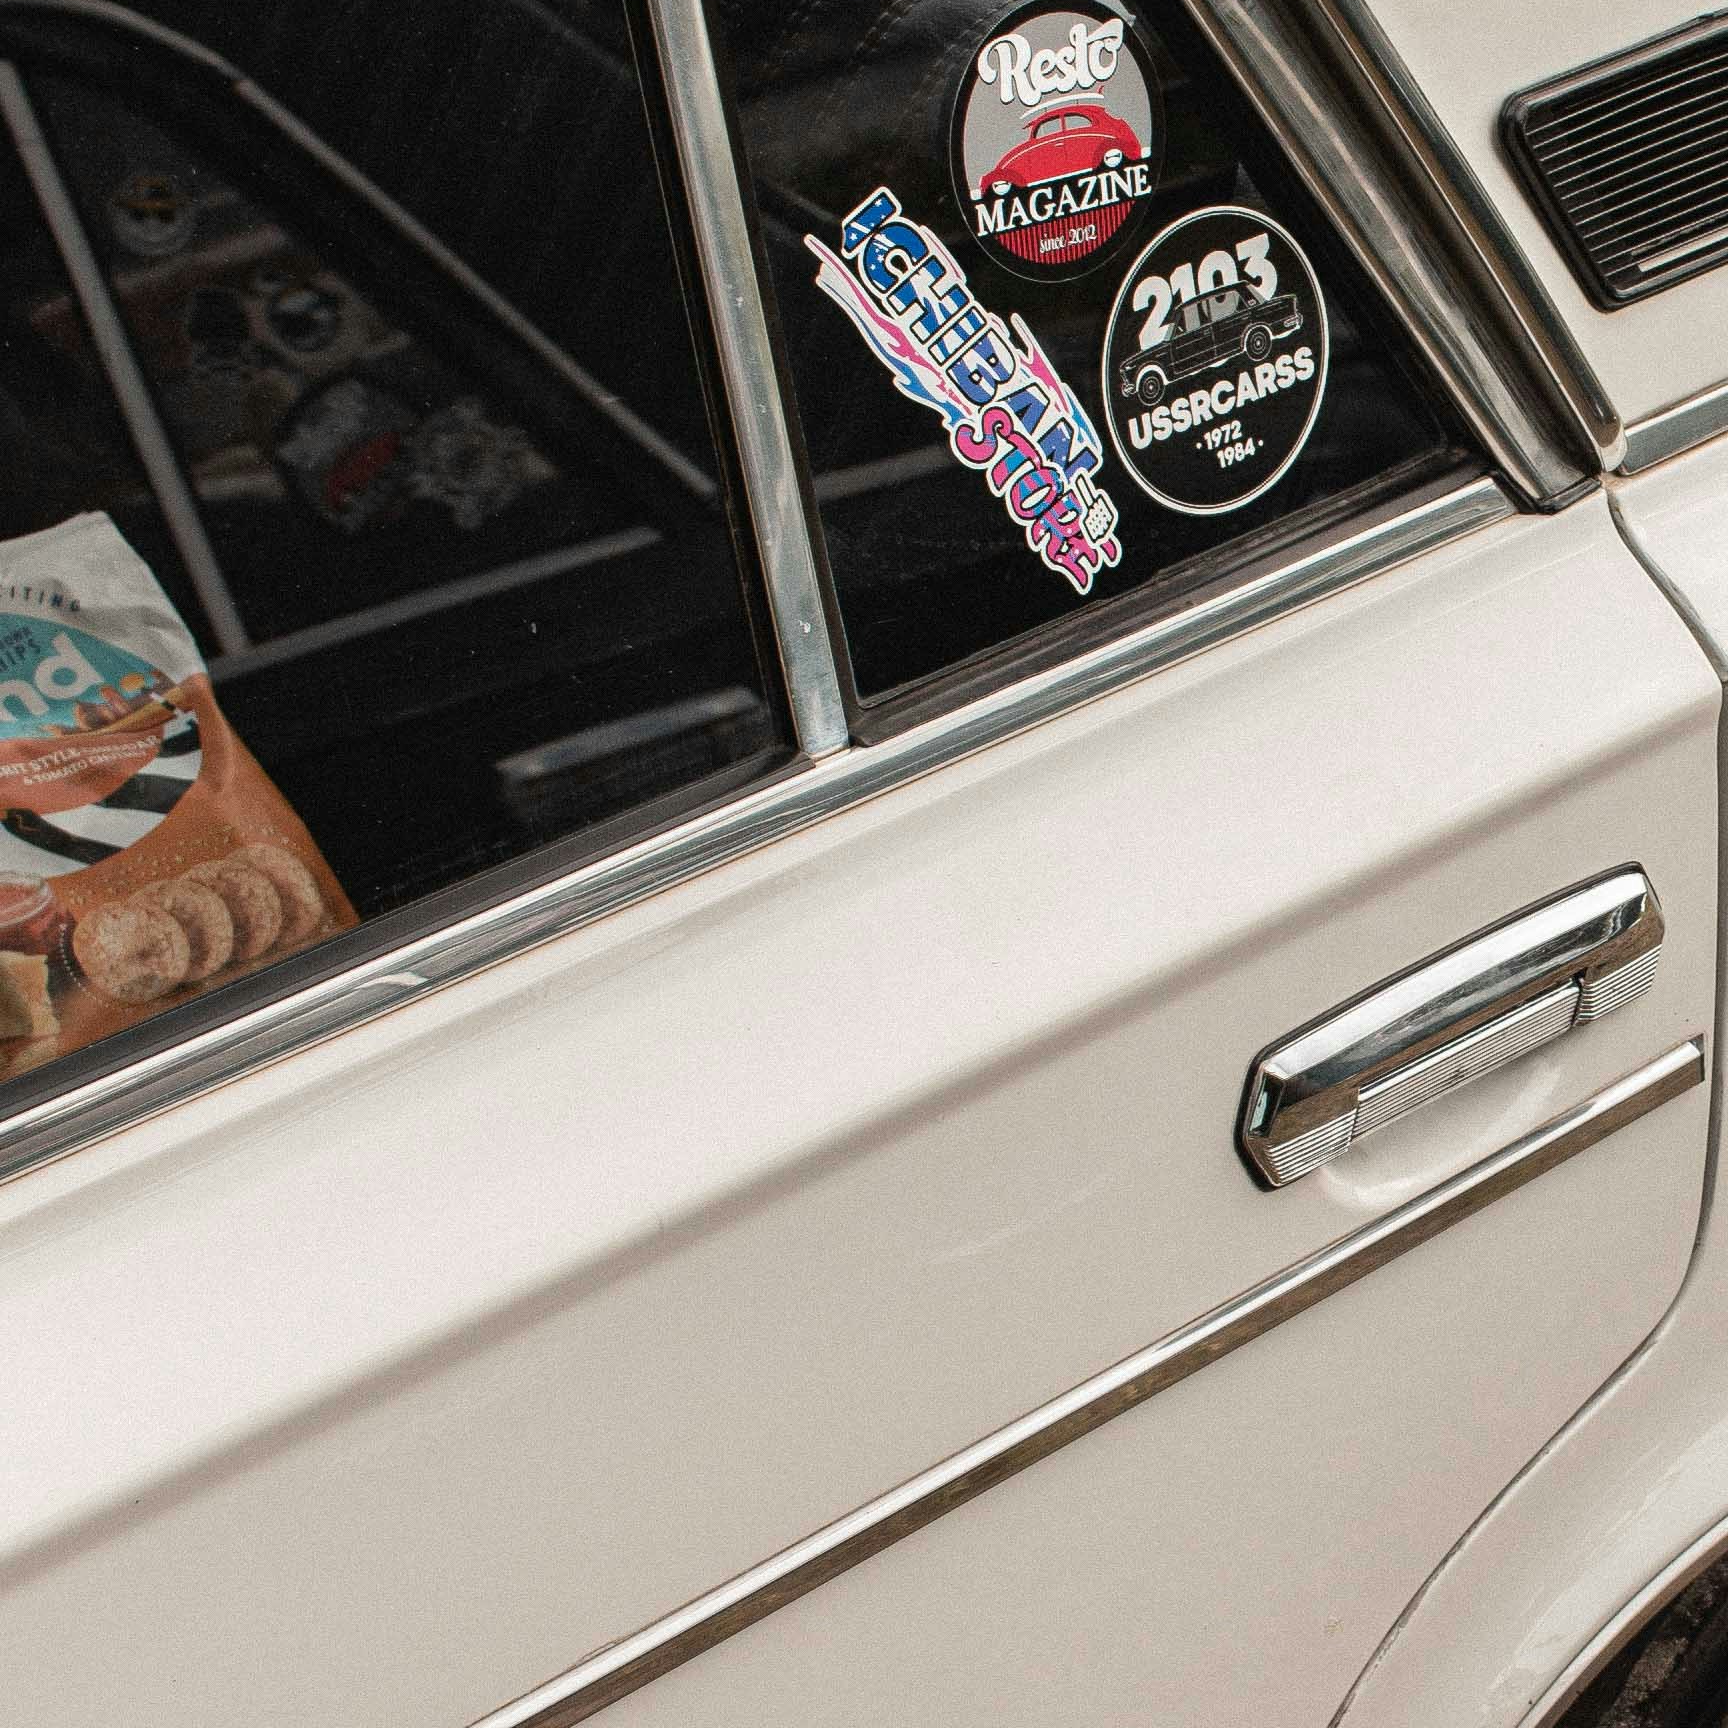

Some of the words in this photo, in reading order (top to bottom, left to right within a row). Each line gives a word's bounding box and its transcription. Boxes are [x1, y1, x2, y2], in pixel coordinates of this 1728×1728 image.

[978, 18, 1124, 106] Resto
[975, 164, 1152, 237] MAGAZINE
[1039, 233, 1066, 254] since
[1067, 224, 1098, 246] 2012
[842, 194, 1099, 484] ICHIBAN
[1132, 233, 1278, 351] 2103
[1128, 346, 1315, 450] USSRCARSS
[956, 406, 1117, 589] STORE
